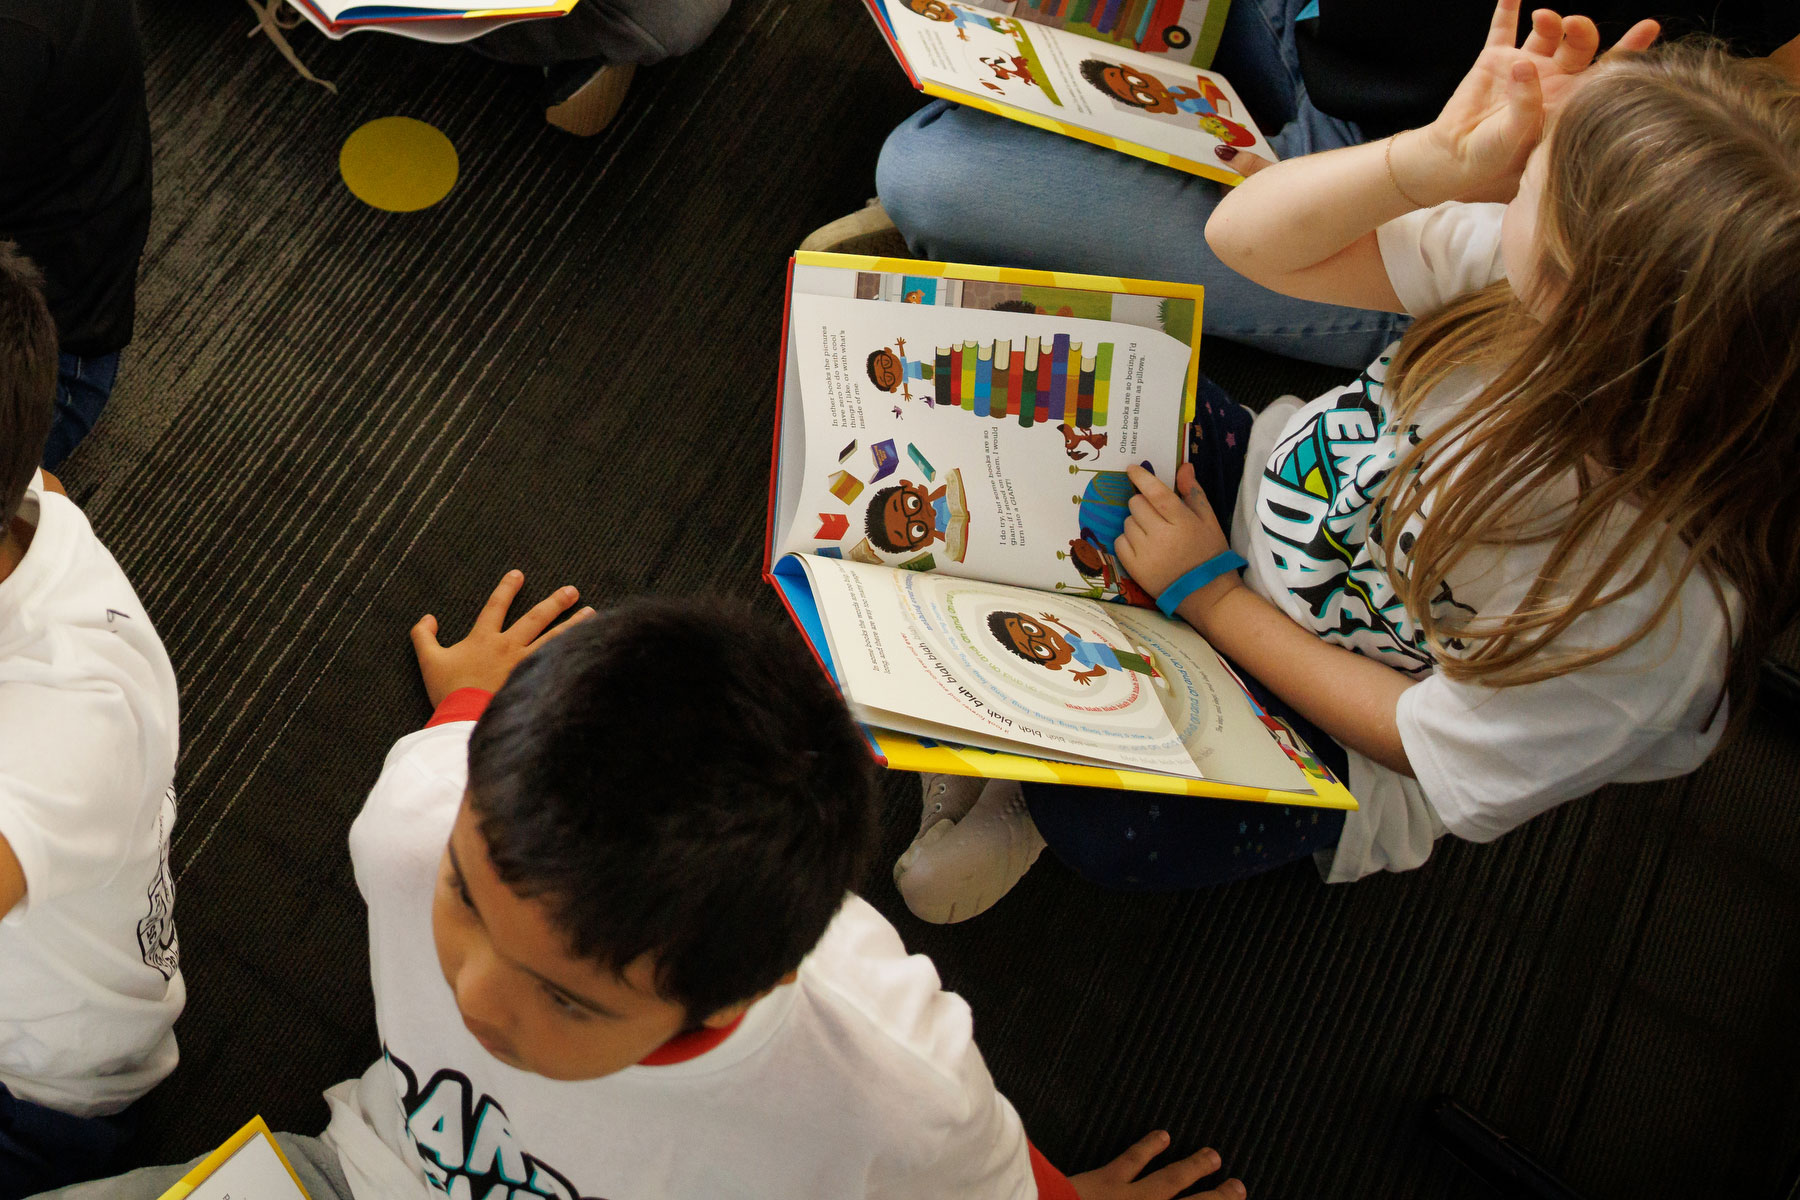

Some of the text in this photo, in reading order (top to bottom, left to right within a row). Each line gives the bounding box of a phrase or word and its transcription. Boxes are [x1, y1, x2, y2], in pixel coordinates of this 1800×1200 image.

[1128, 342, 1137, 352] I'd
[1124, 352, 1137, 381] boring,
[1136, 355, 1146, 385] pillows.
[1125, 381, 1132, 391] so
[1135, 385, 1142, 394] as
[1132, 395, 1141, 415] them
[1120, 406, 1130, 430] books
[1119, 431, 1128, 454] Other
[1129, 431, 1138, 455] rather
[935, 662, 1013, 727] blah blah blah
